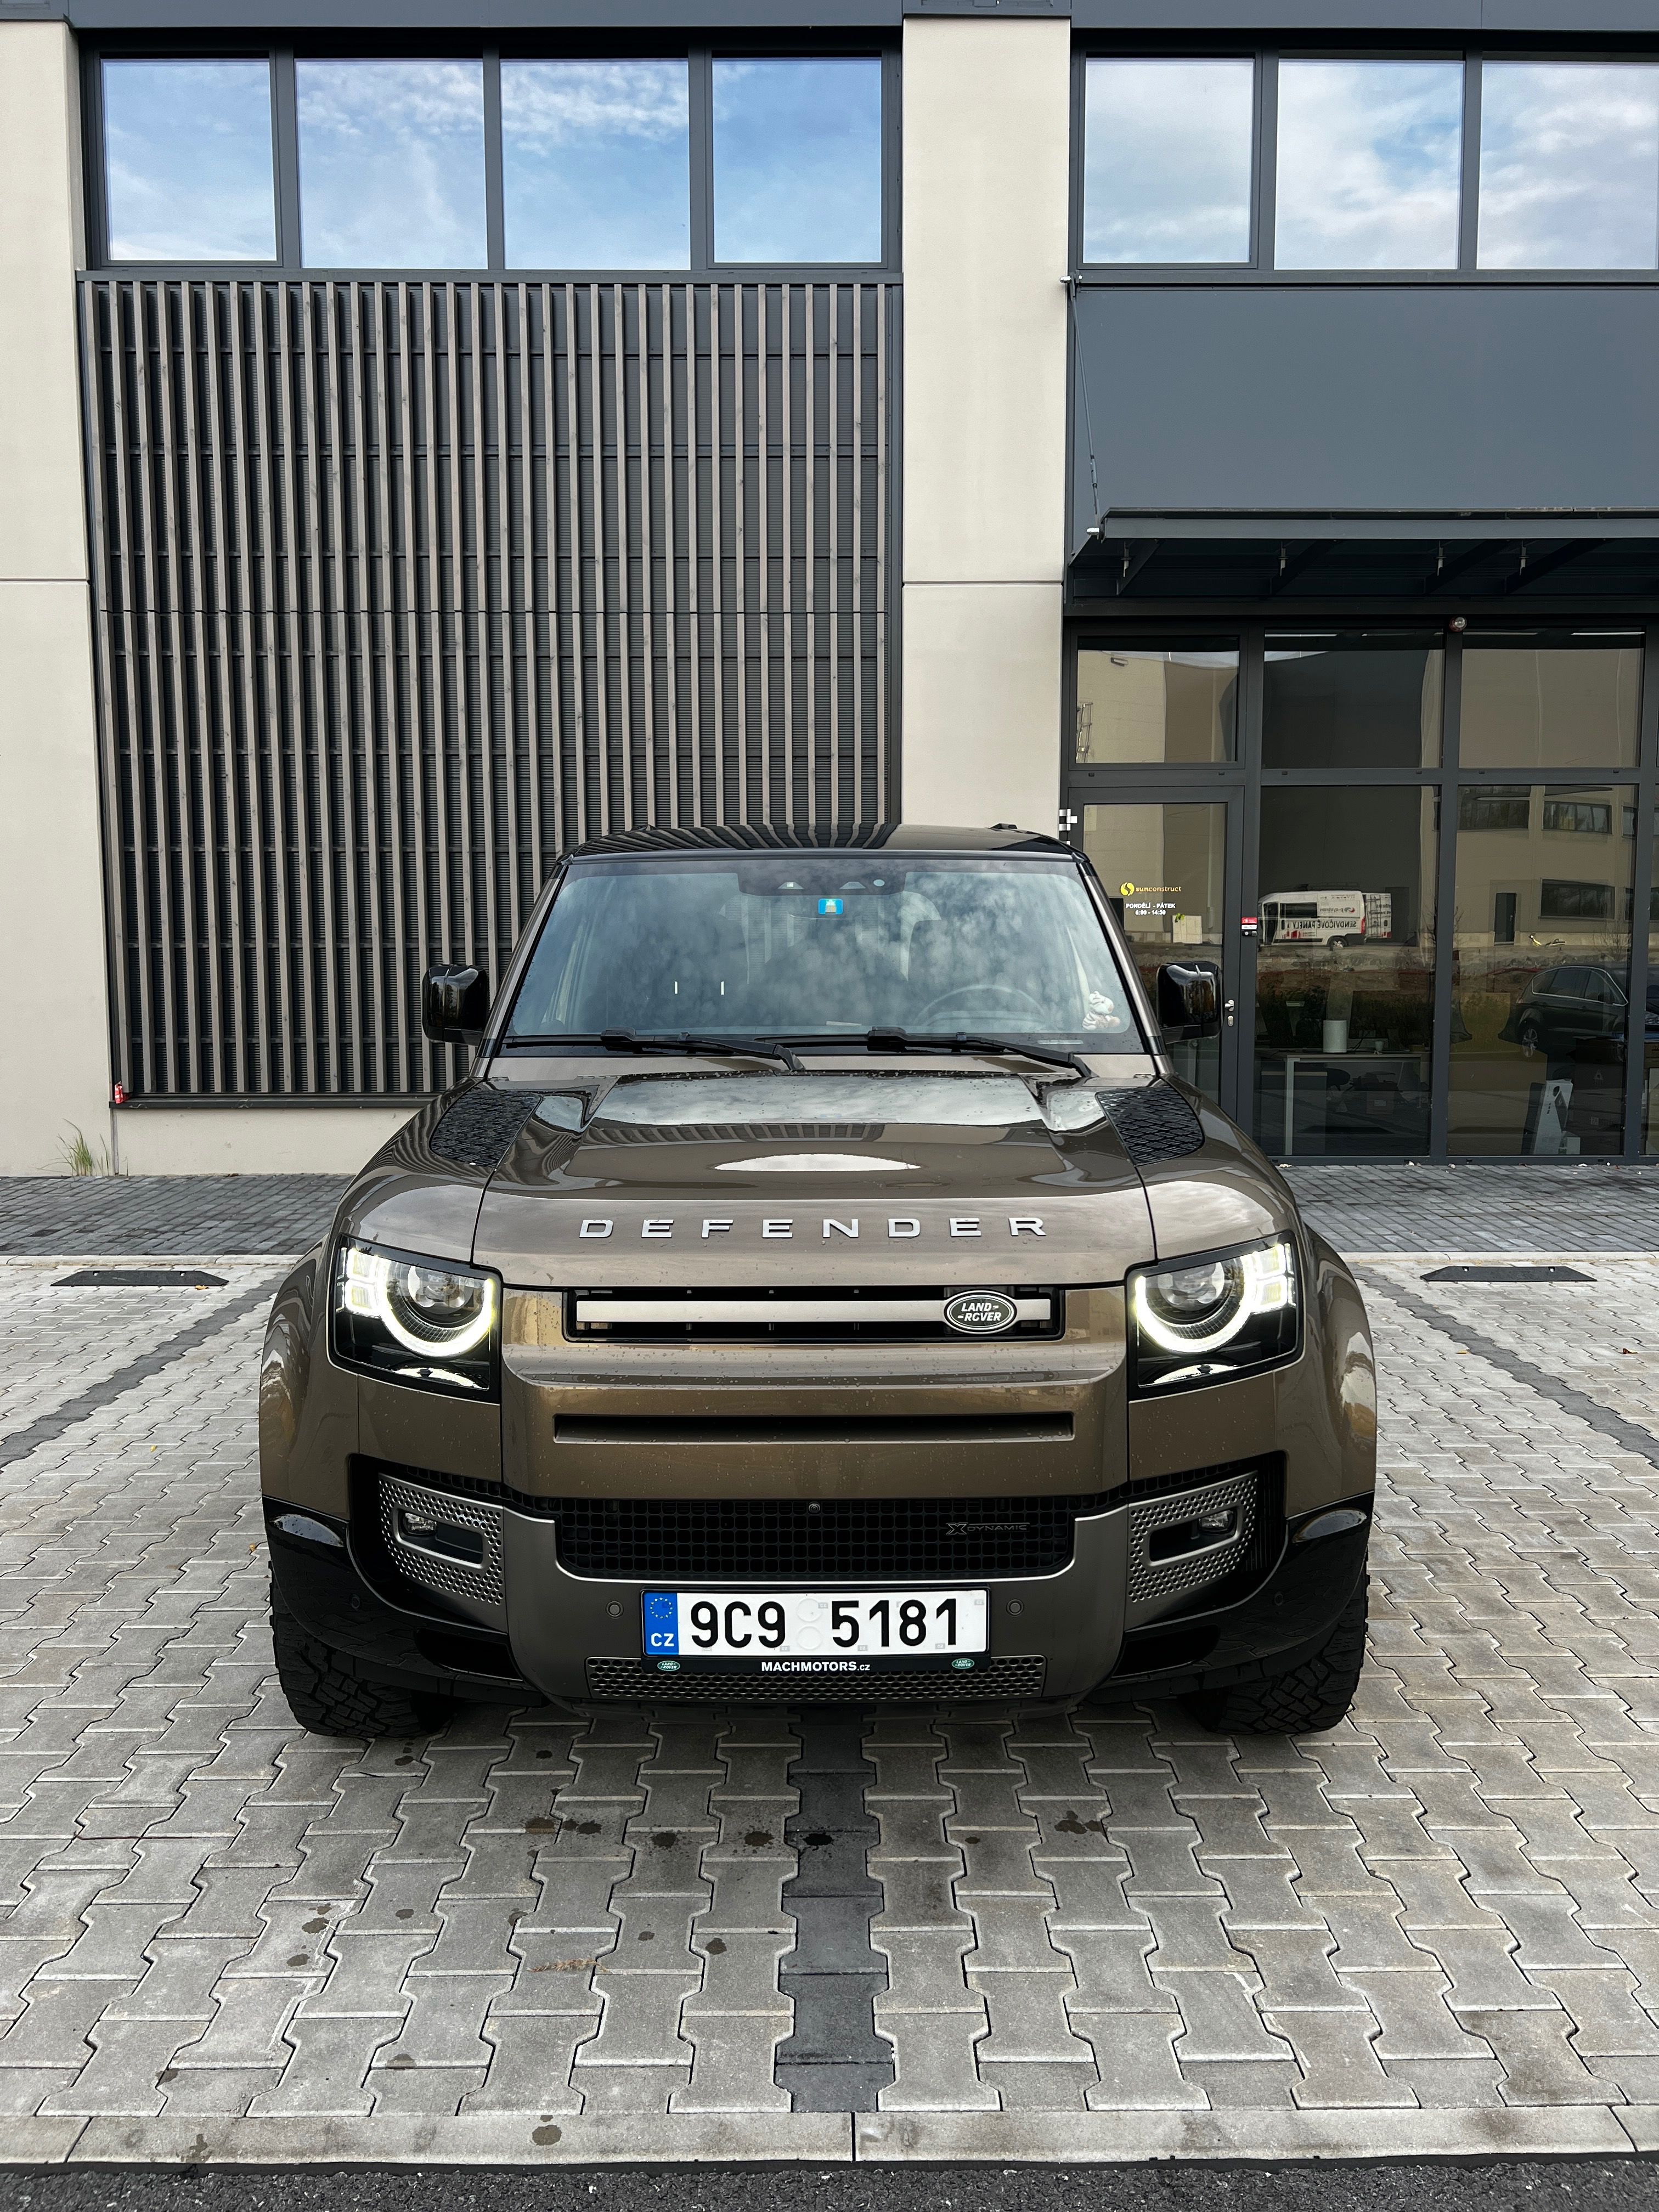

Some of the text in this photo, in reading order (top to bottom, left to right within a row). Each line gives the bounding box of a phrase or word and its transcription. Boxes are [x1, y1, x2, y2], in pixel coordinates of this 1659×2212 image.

[580, 1217, 1046, 1239] DEFENDER
[961, 1303, 992, 1312] LAND
[964, 1312, 1001, 1322] ROVER
[691, 1599, 956, 1648] 9C9 5181
[651, 1633, 674, 1647] CZ
[761, 1661, 870, 1672] MACHMOTORS.cz
